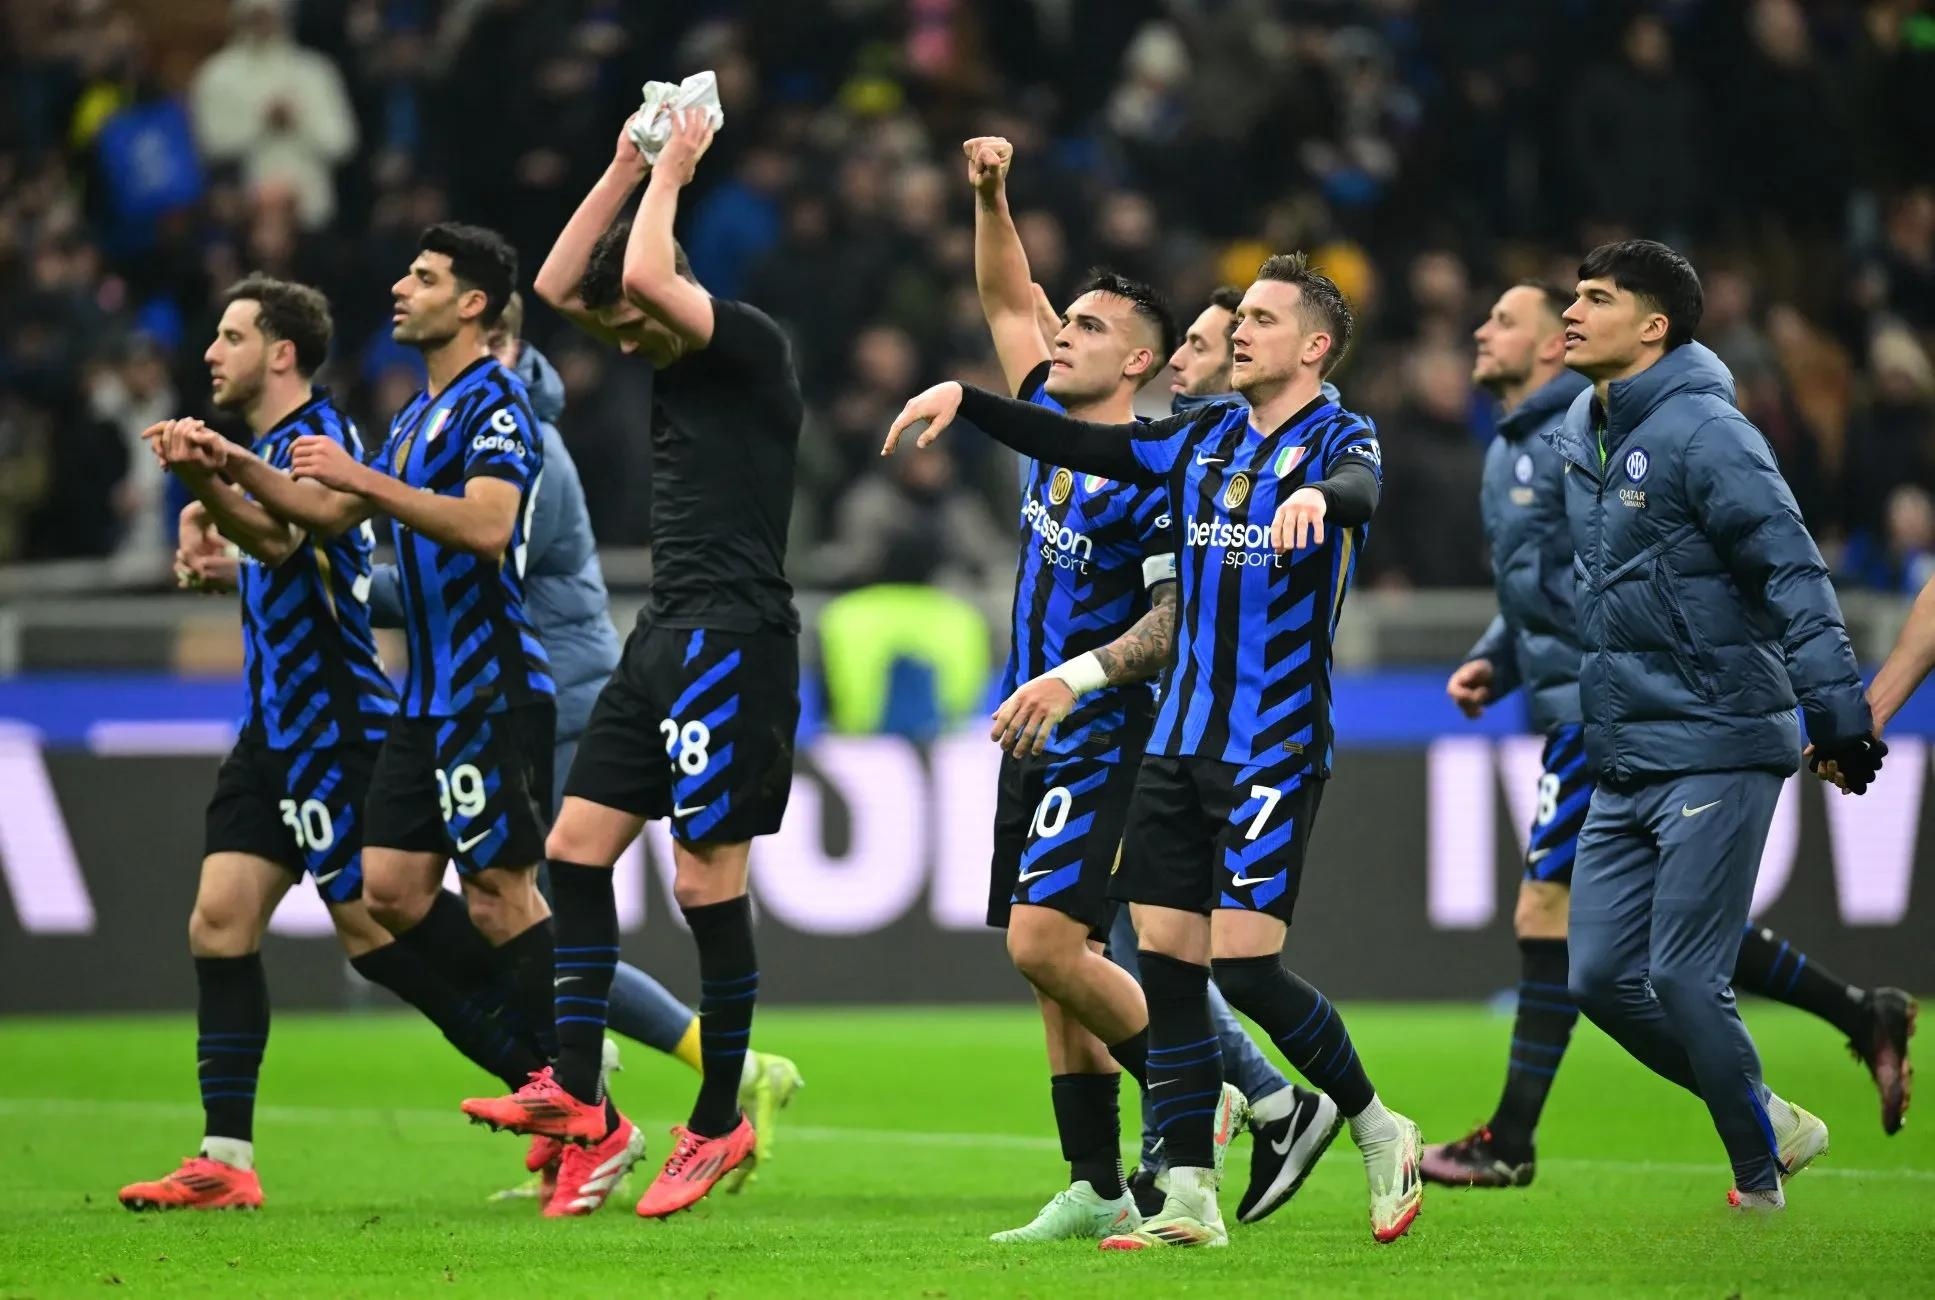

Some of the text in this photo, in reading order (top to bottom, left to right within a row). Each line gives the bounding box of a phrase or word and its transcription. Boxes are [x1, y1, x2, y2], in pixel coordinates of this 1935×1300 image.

[1619, 489, 1645, 502] QATAR
[1221, 550, 1283, 568] .sport
[659, 718, 711, 776] 28
[1244, 784, 1282, 840] 7
